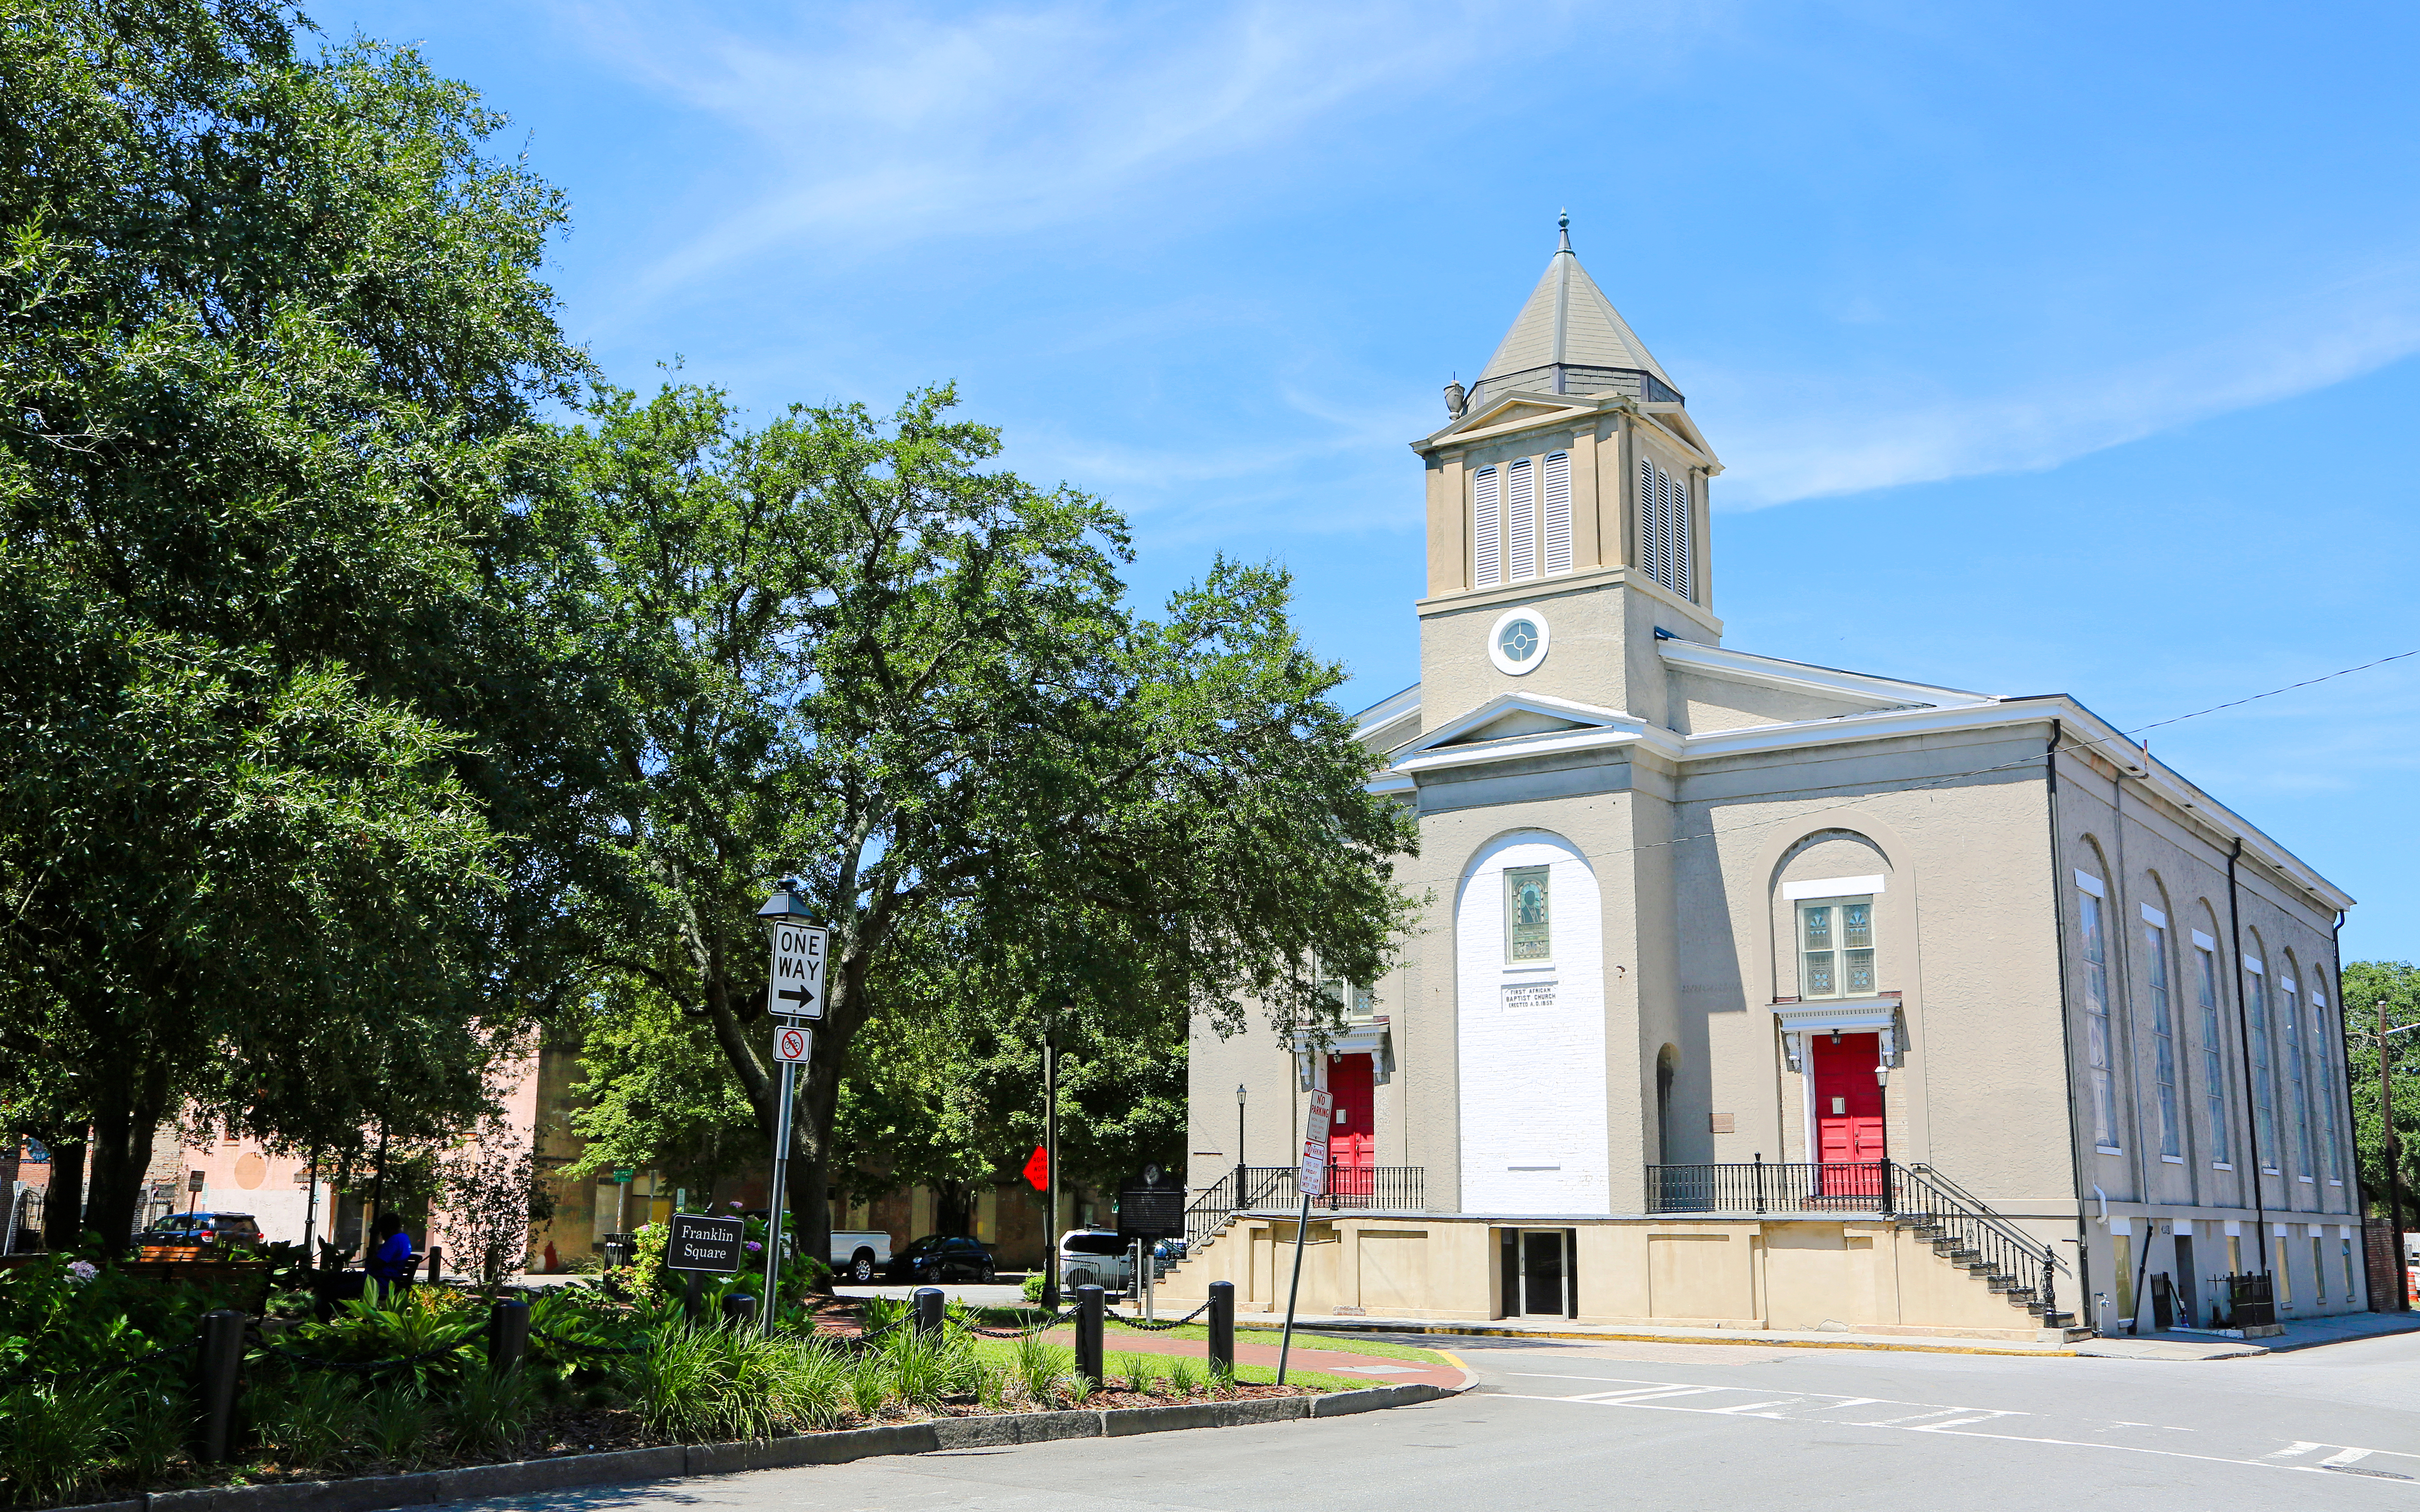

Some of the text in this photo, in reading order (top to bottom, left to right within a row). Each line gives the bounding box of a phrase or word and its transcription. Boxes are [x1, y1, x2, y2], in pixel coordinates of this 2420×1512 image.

[781, 932, 820, 956] ONE
[779, 956, 820, 980] WAY
[1317, 1095, 1325, 1105] NO
[1311, 1105, 1329, 1117] PARKING
[1304, 1144, 1324, 1156] NO PARKING
[681, 1225, 733, 1242] Franklin
[684, 1243, 726, 1260] Square
